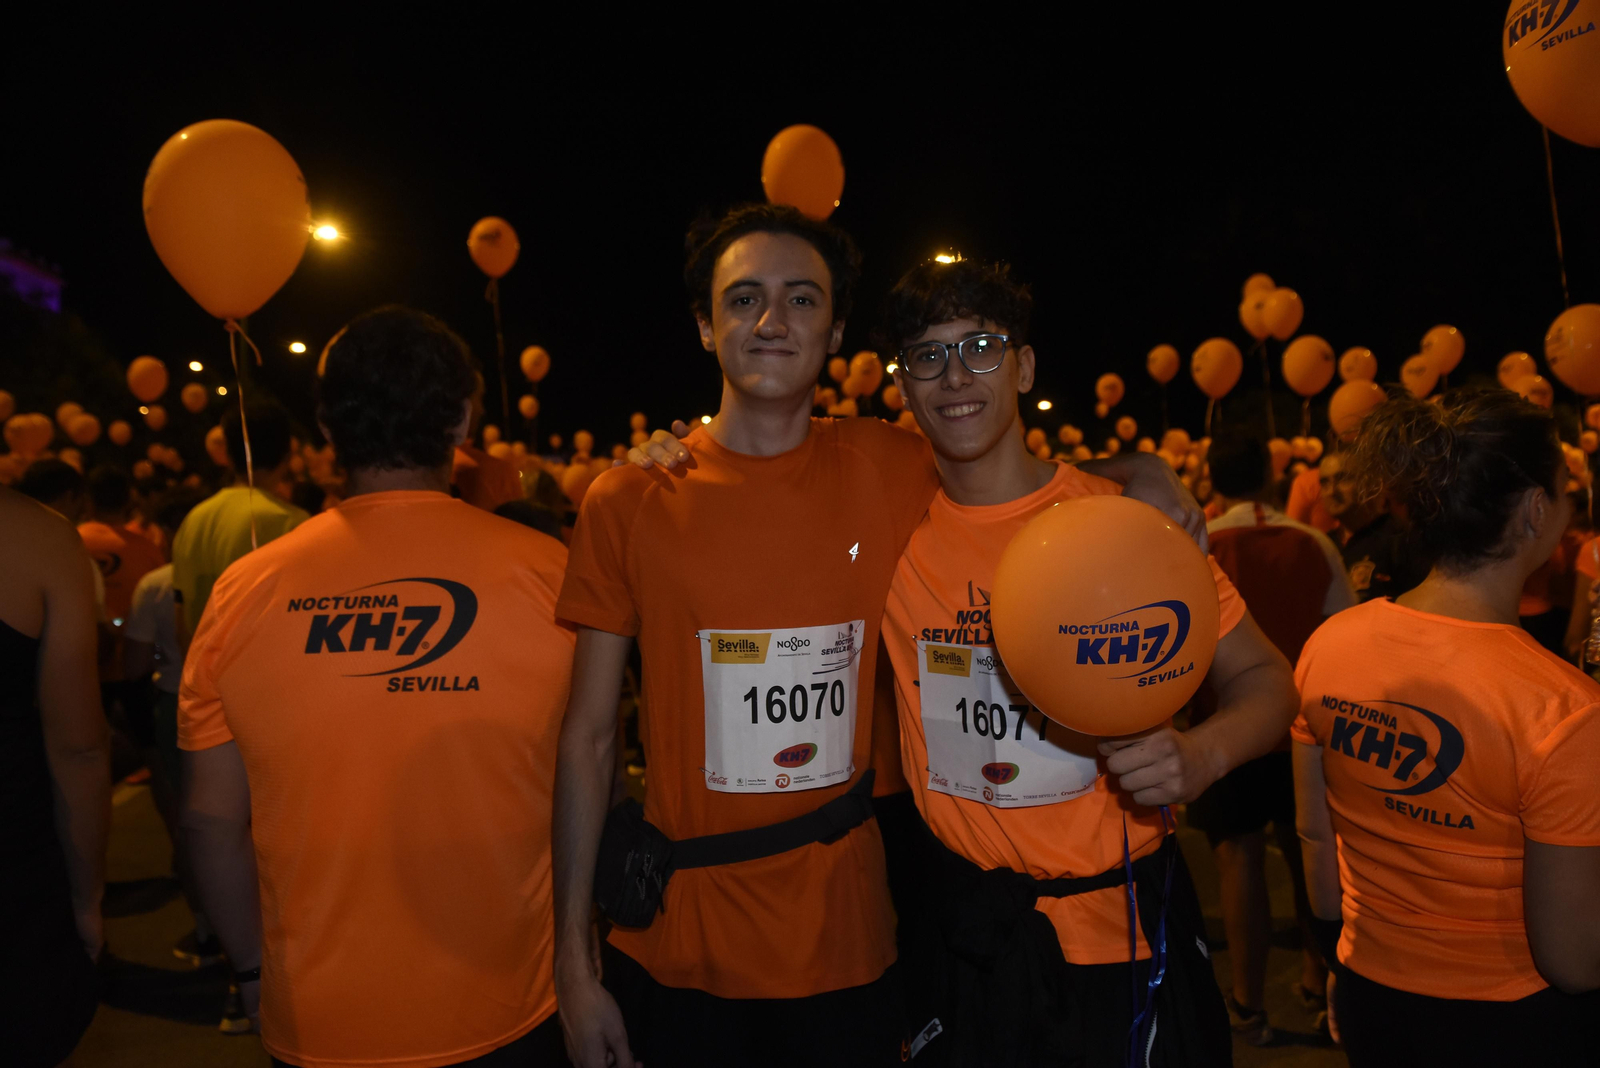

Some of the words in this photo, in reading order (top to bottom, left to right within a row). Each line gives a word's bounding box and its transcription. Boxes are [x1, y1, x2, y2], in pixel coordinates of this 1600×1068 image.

[1541, 22, 1596, 51] SEVILLA
[287, 595, 399, 612] NOCTURNA
[304, 605, 442, 656] KH-7
[1058, 621, 1140, 635] NOCTURNA
[1076, 622, 1170, 665] KH-7
[386, 676, 480, 693] SEVILLA
[1137, 662, 1195, 688] SEVILLA
[743, 679, 845, 724] 16070
[955, 697, 1049, 741] 16077
[1321, 694, 1398, 731] NOCTURNA
[1330, 716, 1428, 782] KH-7
[1384, 796, 1475, 830] SEVILLA
